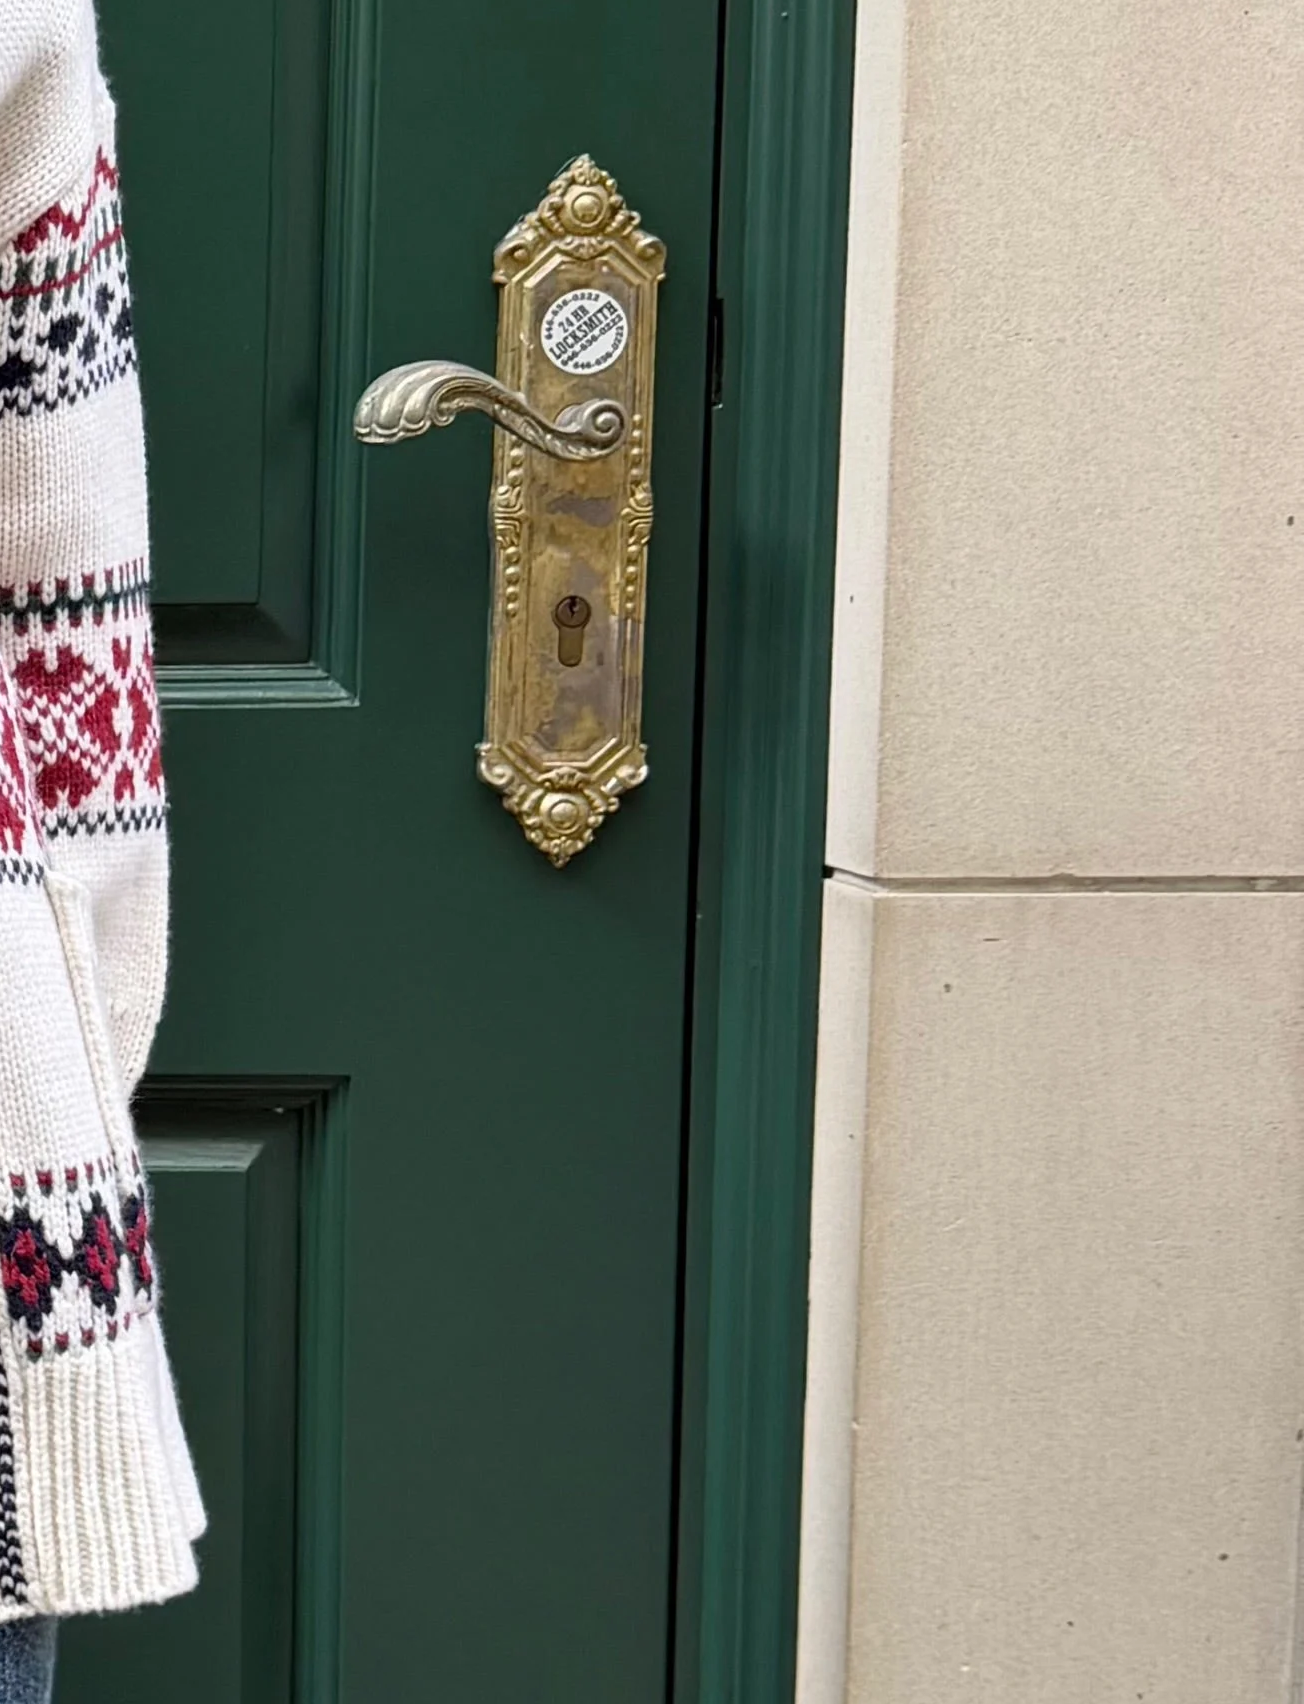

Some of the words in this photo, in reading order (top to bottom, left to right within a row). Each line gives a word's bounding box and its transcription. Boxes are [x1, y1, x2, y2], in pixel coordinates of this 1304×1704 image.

[549, 300, 618, 360] LOCKSMITH
[558, 316, 574, 333] 24
[570, 304, 590, 322] HR
